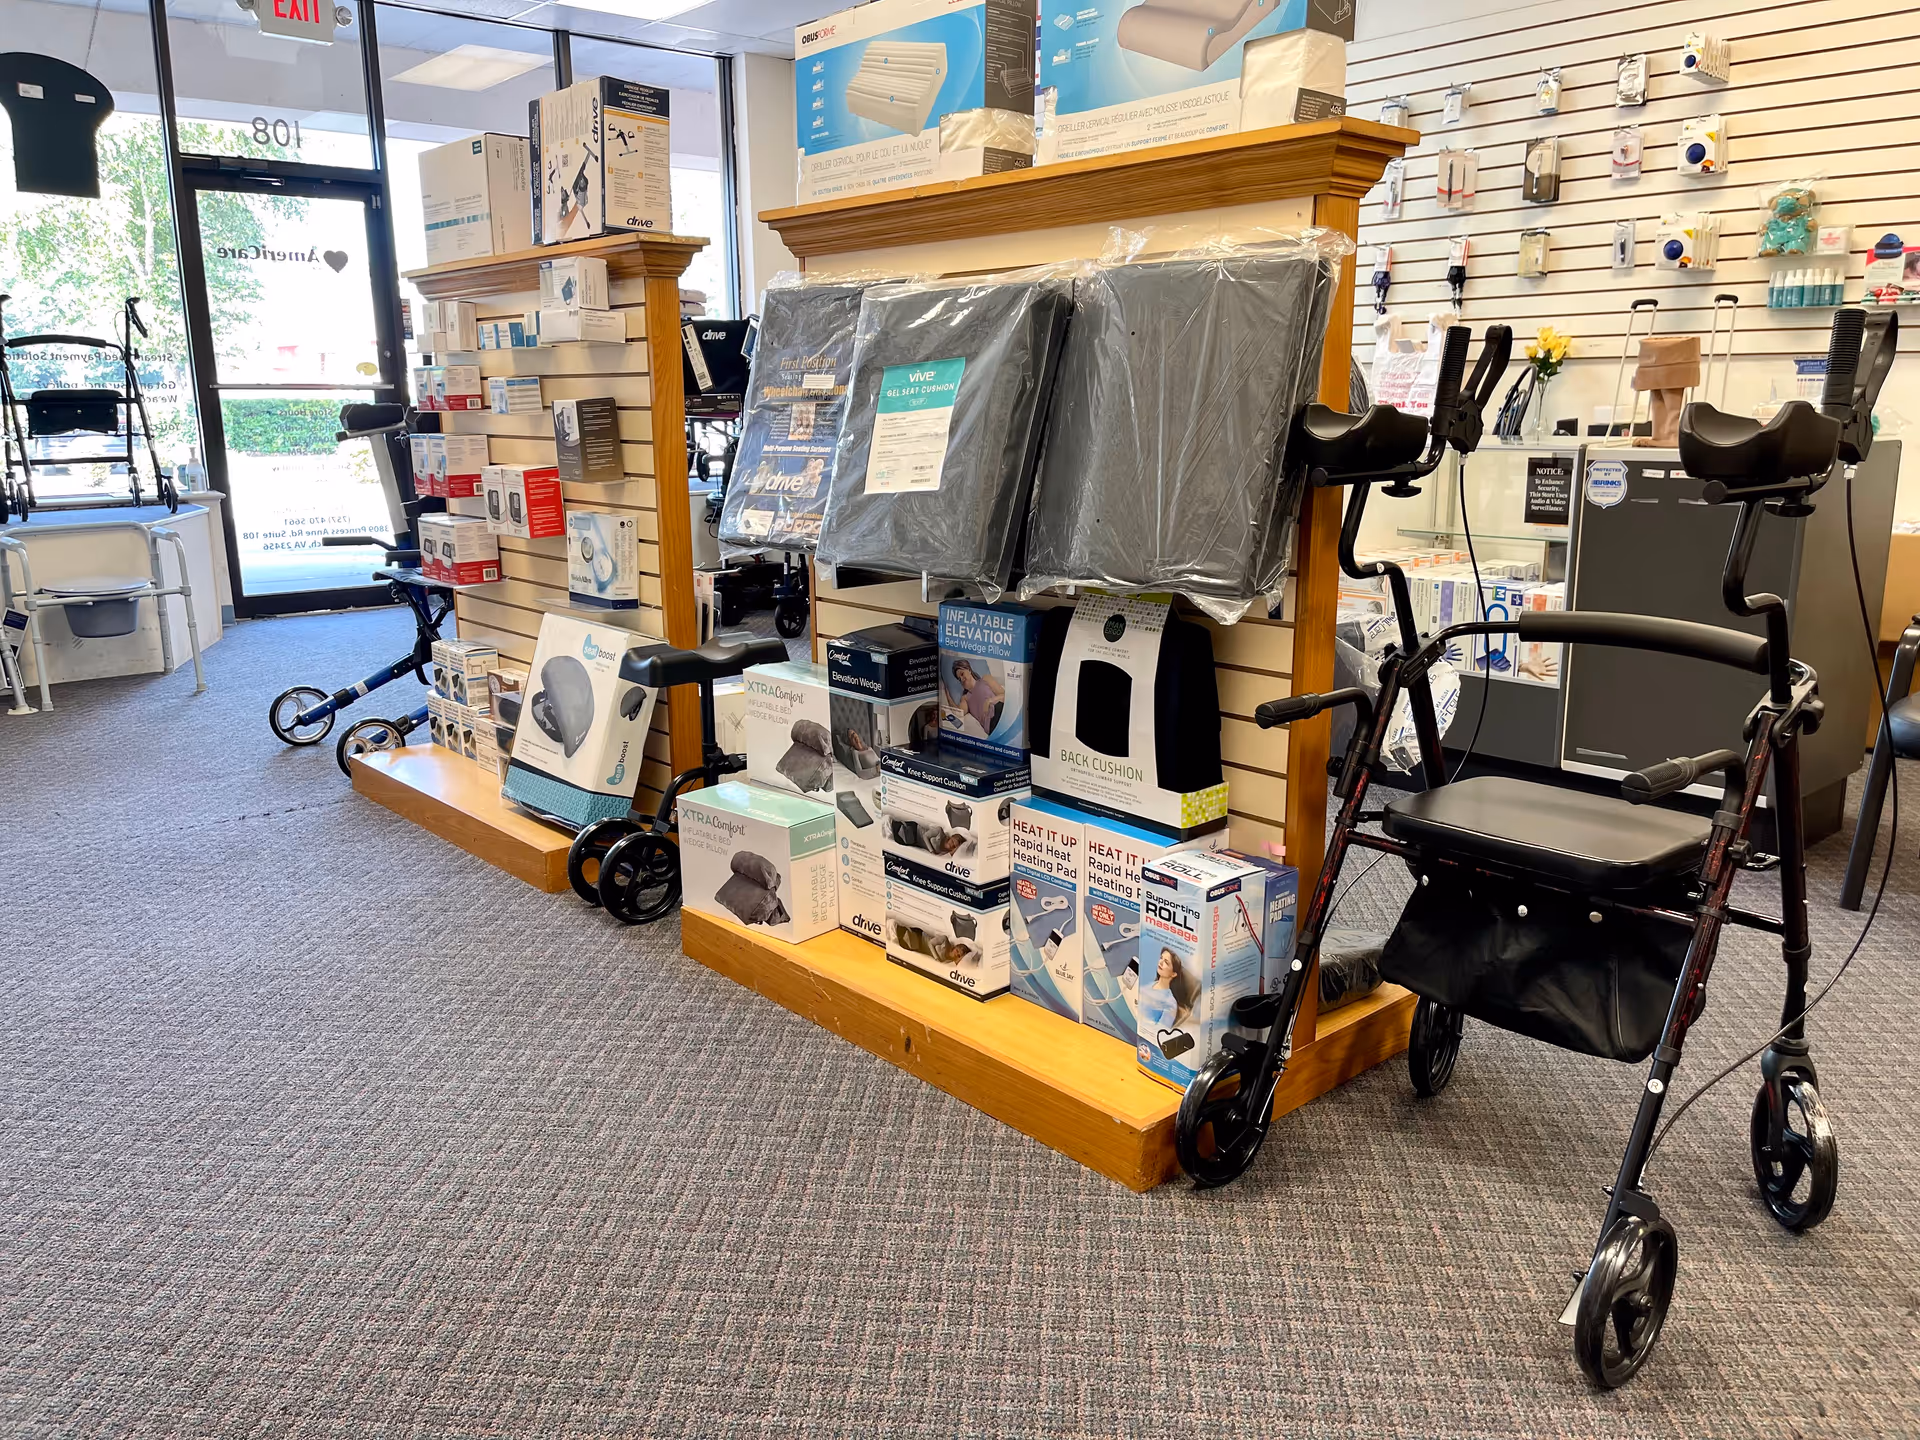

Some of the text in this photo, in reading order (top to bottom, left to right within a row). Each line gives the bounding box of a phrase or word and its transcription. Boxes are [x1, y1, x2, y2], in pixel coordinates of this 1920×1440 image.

[274, 0, 320, 24] EXIT
[802, 26, 836, 44] OBUSFORME
[1139, 108, 1153, 119] AVEC
[1153, 102, 1178, 116] MOUSSE
[1131, 138, 1152, 147] SUPPORT
[1152, 134, 1168, 143] FERME
[1174, 130, 1198, 140] BEAUCOUP
[1206, 124, 1228, 133] CONFORT
[856, 151, 871, 164] POUR
[872, 150, 878, 160] LE
[893, 145, 900, 156] ET
[901, 144, 908, 154] LA
[626, 216, 653, 228] drive
[702, 330, 726, 340] drive
[780, 354, 837, 369] First Position
[909, 370, 935, 382] vive
[887, 383, 955, 397] GEL SEAT CUSHION
[765, 471, 804, 492] drive
[1496, 588, 1505, 599] M
[946, 609, 1014, 630] INFLATABLE
[945, 623, 1012, 646] ELEVATION
[583, 646, 616, 662] seat boost
[829, 649, 851, 661] Comfort
[945, 637, 1011, 657] Bed Wedge Pillow
[832, 671, 882, 691] Elevation Wedge
[747, 680, 804, 707] XTRAComfort
[748, 699, 792, 715] INFLATABLE BED
[768, 714, 789, 725] PILLOW
[618, 741, 630, 764] boost
[976, 741, 994, 750] elevation
[1004, 747, 1020, 757] comfort
[882, 755, 966, 790] Comfort Knee Support Cushion
[1060, 749, 1143, 782] BACK CUSHION
[962, 775, 974, 783] NEW!
[682, 807, 746, 838] XTRAComfort
[682, 826, 732, 846] INFLATABLE BED
[1013, 819, 1077, 848] HEAT IT UP
[684, 838, 729, 856] WEDGE PILLOW
[1013, 834, 1071, 862] Rapid Heat
[1089, 841, 1122, 861] HEAT
[1126, 853, 1138, 866] IT
[945, 861, 971, 878] drive
[1014, 848, 1077, 879] Heating Pad
[1027, 868, 1040, 878] Digital
[1089, 856, 1121, 877] Rapid
[1160, 861, 1202, 880] ROLL
[887, 861, 971, 902] Comfort Knee Support Cushion
[1089, 871, 1132, 898] Heating
[1144, 870, 1175, 886] OBUSFORME
[1104, 893, 1118, 902] Digital
[1210, 884, 1239, 897] OBUSFORME
[1146, 890, 1200, 919] Supporting
[1270, 893, 1296, 914] HEATING
[853, 914, 881, 935] drive
[1146, 900, 1194, 932] ROLL
[1269, 910, 1282, 924] PAD
[1146, 916, 1198, 943] massage
[1211, 905, 1219, 969] massage
[950, 970, 976, 987] drive
